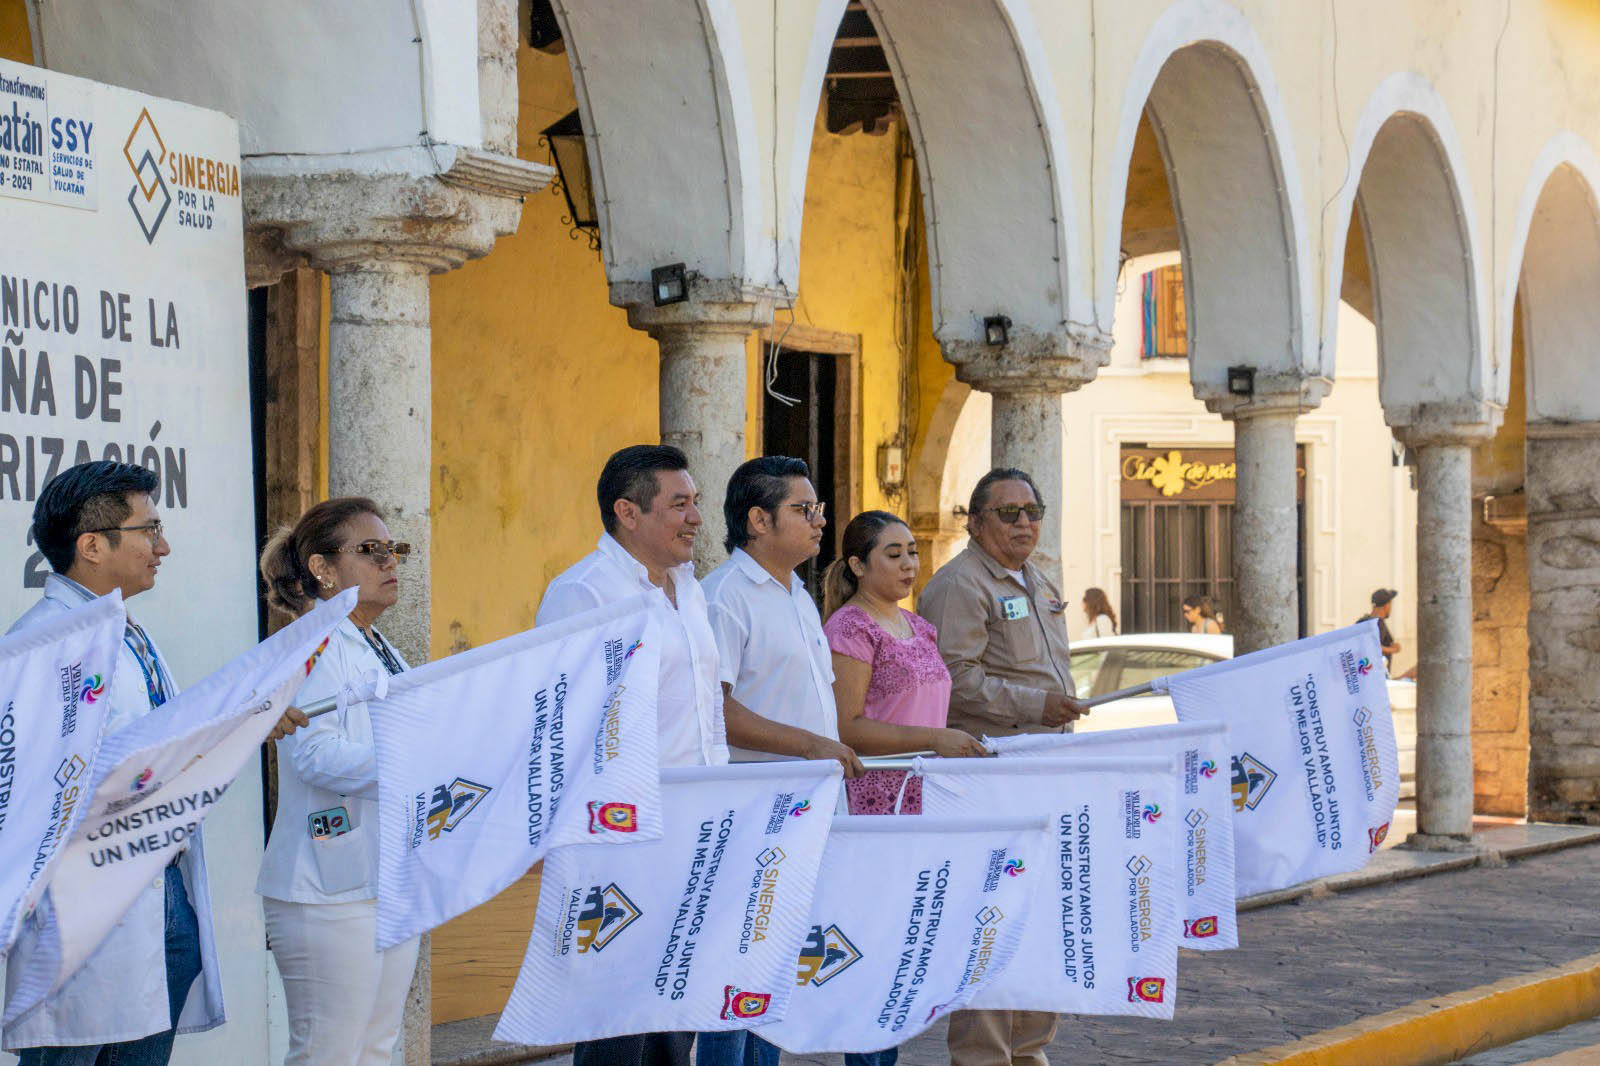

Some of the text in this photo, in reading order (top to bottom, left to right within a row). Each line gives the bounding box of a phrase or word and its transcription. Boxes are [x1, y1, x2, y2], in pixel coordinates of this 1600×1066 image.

[51, 117, 93, 154] SSY
[52, 152, 93, 170] SERVICIOS DE
[14, 157, 43, 175] ESTATAL
[53, 165, 84, 181] SALUD DE
[169, 151, 240, 197] SINERGIA
[178, 190, 215, 212] POR LA
[178, 210, 213, 230] SALUD
[1, 274, 180, 350] NICIO DE LA
[1, 328, 123, 423] ÑA DE
[534, 688, 548, 713] UN
[1289, 685, 1301, 706] UN
[1295, 709, 1312, 757] MEJOR
[605, 700, 621, 762] SINERGIA
[1355, 728, 1375, 802] POR VALLADOLID
[1361, 725, 1383, 791] SINERGIA
[51, 791, 63, 821] POR
[412, 791, 426, 849] VALLADOLID
[1060, 813, 1072, 836] UN
[1328, 795, 1342, 850] JUNTOS
[90, 845, 123, 867] UN
[697, 821, 714, 846] UN
[1194, 828, 1207, 886] SINERGIA
[683, 846, 707, 897] MEJOR
[918, 870, 931, 892] UN
[1060, 841, 1073, 891] MEJOR
[1186, 829, 1195, 897] POR VALLADOLID
[561, 887, 583, 956] VALLADOLID
[739, 869, 764, 955] POR VALLADOLID
[752, 868, 779, 943] SINERGIA
[905, 894, 927, 945] MEJOR
[1129, 877, 1140, 953] POR VALLADOLID
[1137, 876, 1153, 942] SINERGIA
[969, 927, 997, 985] SINERGIA
[971, 927, 983, 946] POR
[670, 937, 696, 1001] JUNTOS
[1081, 936, 1095, 990] JUNTOS
[891, 986, 918, 1032] JUNTOS
